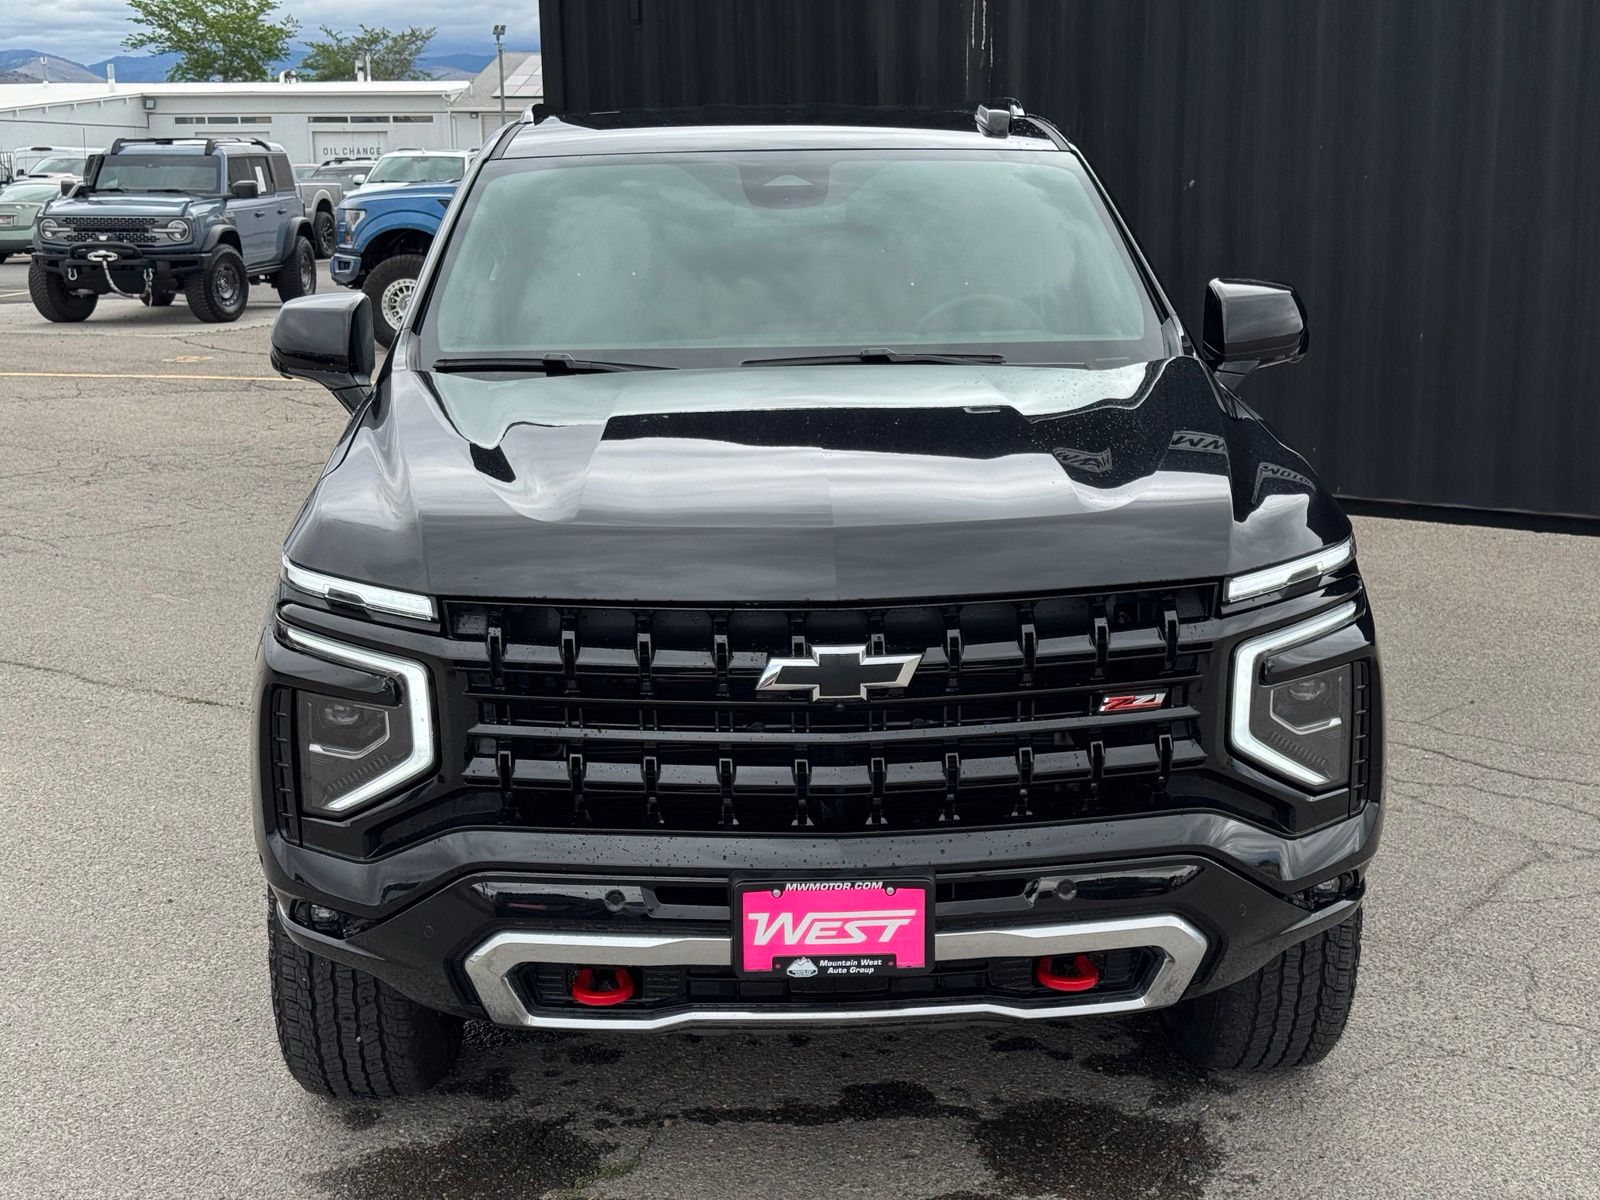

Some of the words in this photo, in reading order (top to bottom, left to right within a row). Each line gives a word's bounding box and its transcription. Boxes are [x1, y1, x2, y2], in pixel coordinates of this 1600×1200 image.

[323, 147, 339, 156] OIL
[342, 147, 382, 156] CHANGE
[785, 881, 883, 891] MWMOTOR.COM
